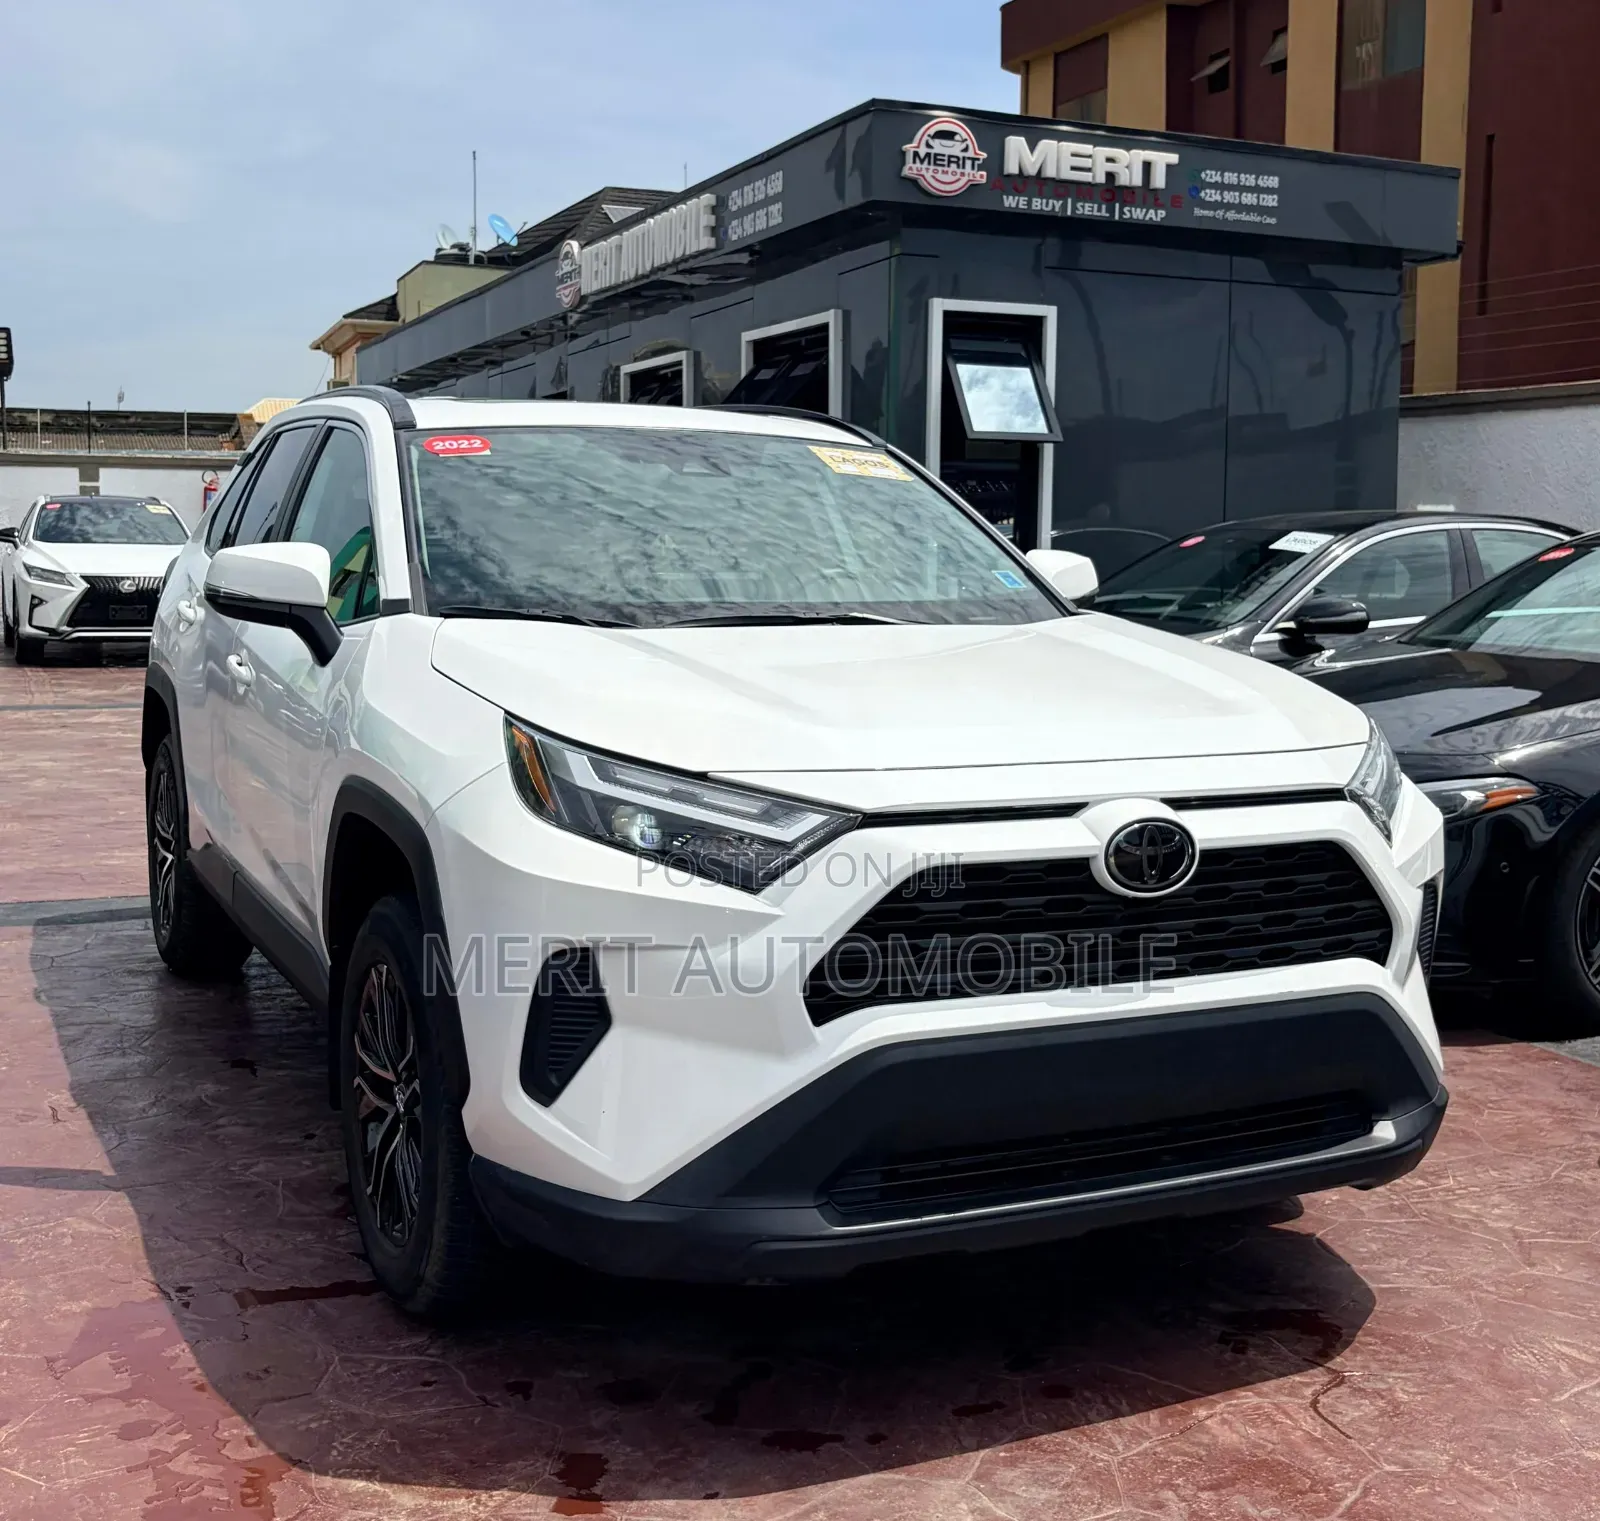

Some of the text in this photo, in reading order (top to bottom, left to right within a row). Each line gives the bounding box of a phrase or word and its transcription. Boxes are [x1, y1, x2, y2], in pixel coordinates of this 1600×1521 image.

[912, 150, 981, 171] MERIT
[1003, 135, 1179, 190] MERIT
[908, 165, 985, 180] AUTOMOBILE
[1200, 169, 1279, 189] +234 816 926 4568
[989, 176, 1185, 209] AUTOMOBILE
[1200, 188, 1278, 207] +234 903 686 1282
[1002, 194, 1028, 210] WE
[1031, 197, 1063, 213] BUY
[1075, 201, 1110, 218] SELL
[1122, 206, 1166, 222] SWAP
[581, 193, 717, 295] MERIT AUTOMOBILE
[432, 439, 484, 450] 2022
[829, 454, 889, 469] LAGOS
